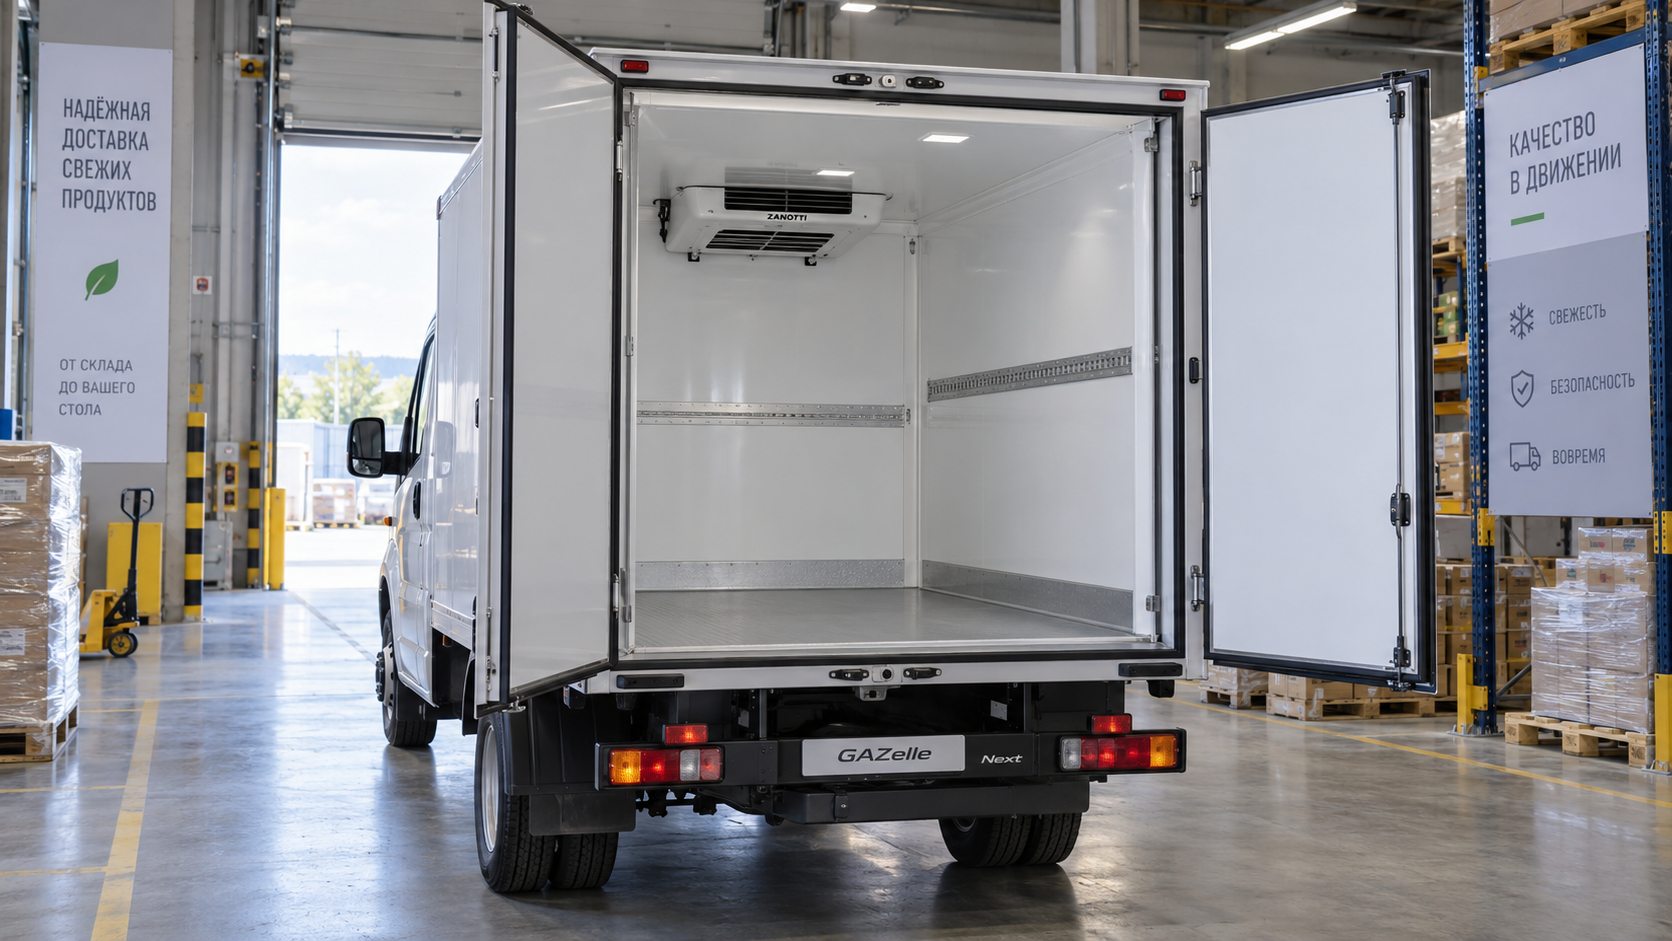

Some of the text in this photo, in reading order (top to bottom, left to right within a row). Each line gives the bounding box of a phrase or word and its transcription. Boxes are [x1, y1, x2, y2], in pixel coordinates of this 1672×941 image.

[64, 96, 150, 122] НАДЁЖНАЯ
[62, 128, 148, 151] ДОСТАВКА
[1510, 111, 1595, 157] КАЧЕСТВО
[63, 158, 131, 180] СВЕЖИХ
[1510, 143, 1621, 195] В ДВИЖЕНИИ
[63, 189, 156, 213] ПРОДУКТОВ
[767, 213, 807, 221] ZANOTTI
[1549, 304, 1606, 325] СВЕЖЕСТЬ
[60, 359, 132, 373] ОТ СКЛАДА
[59, 381, 135, 395] ДО ВАШЕГО
[1551, 373, 1635, 395] БЕЗОПАСНОСТЬ
[59, 404, 101, 416] СТОЛА
[1552, 448, 1605, 465] ВОВРЕМЯ
[838, 747, 1023, 764] GAZelle Next
